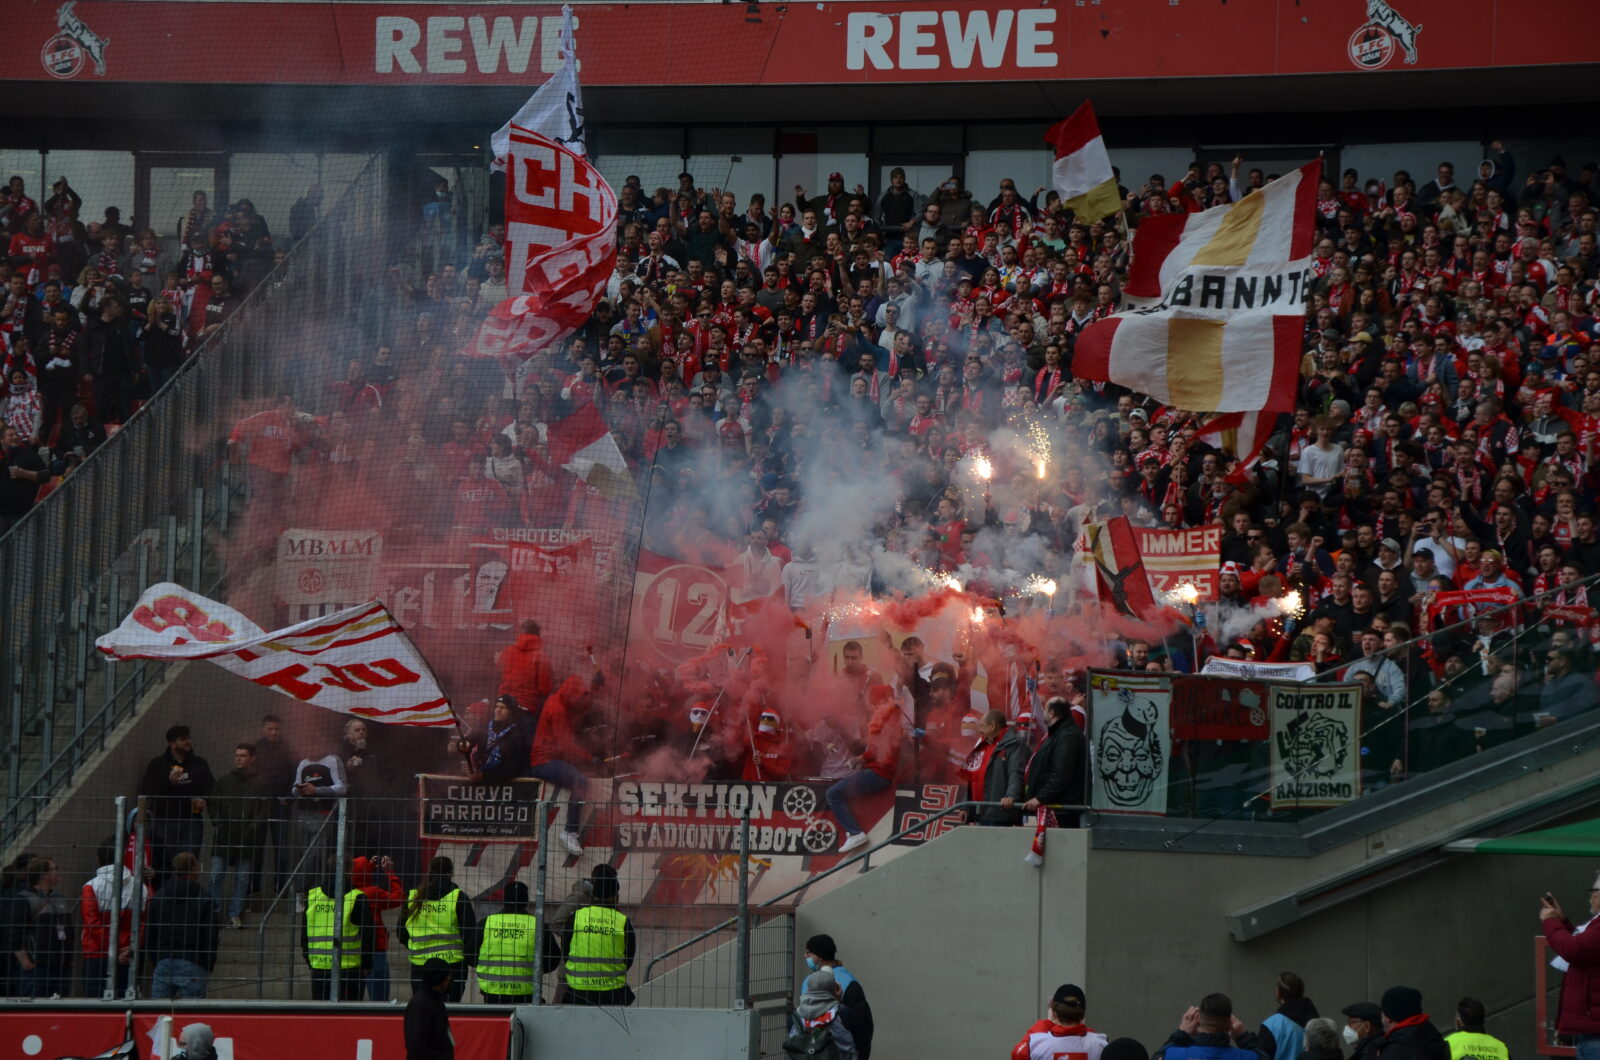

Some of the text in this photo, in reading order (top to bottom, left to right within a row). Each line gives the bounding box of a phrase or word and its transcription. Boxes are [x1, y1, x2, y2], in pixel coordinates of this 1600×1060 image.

[375, 16, 581, 73] REWE
[846, 8, 1058, 69] REWE
[1168, 268, 1309, 310] BANNTE
[286, 539, 373, 556] MBMM
[1142, 528, 1219, 554] IMMER
[653, 577, 722, 651] 12
[1276, 693, 1353, 710] CONTRO IL
[448, 786, 512, 801] CURVA
[618, 781, 777, 819] SEKTION
[1276, 783, 1352, 799] RAZZISMO
[619, 822, 802, 853] STADIONVERBOT
[494, 929, 525, 940] ORDNER
[584, 925, 615, 937] ORDNER
